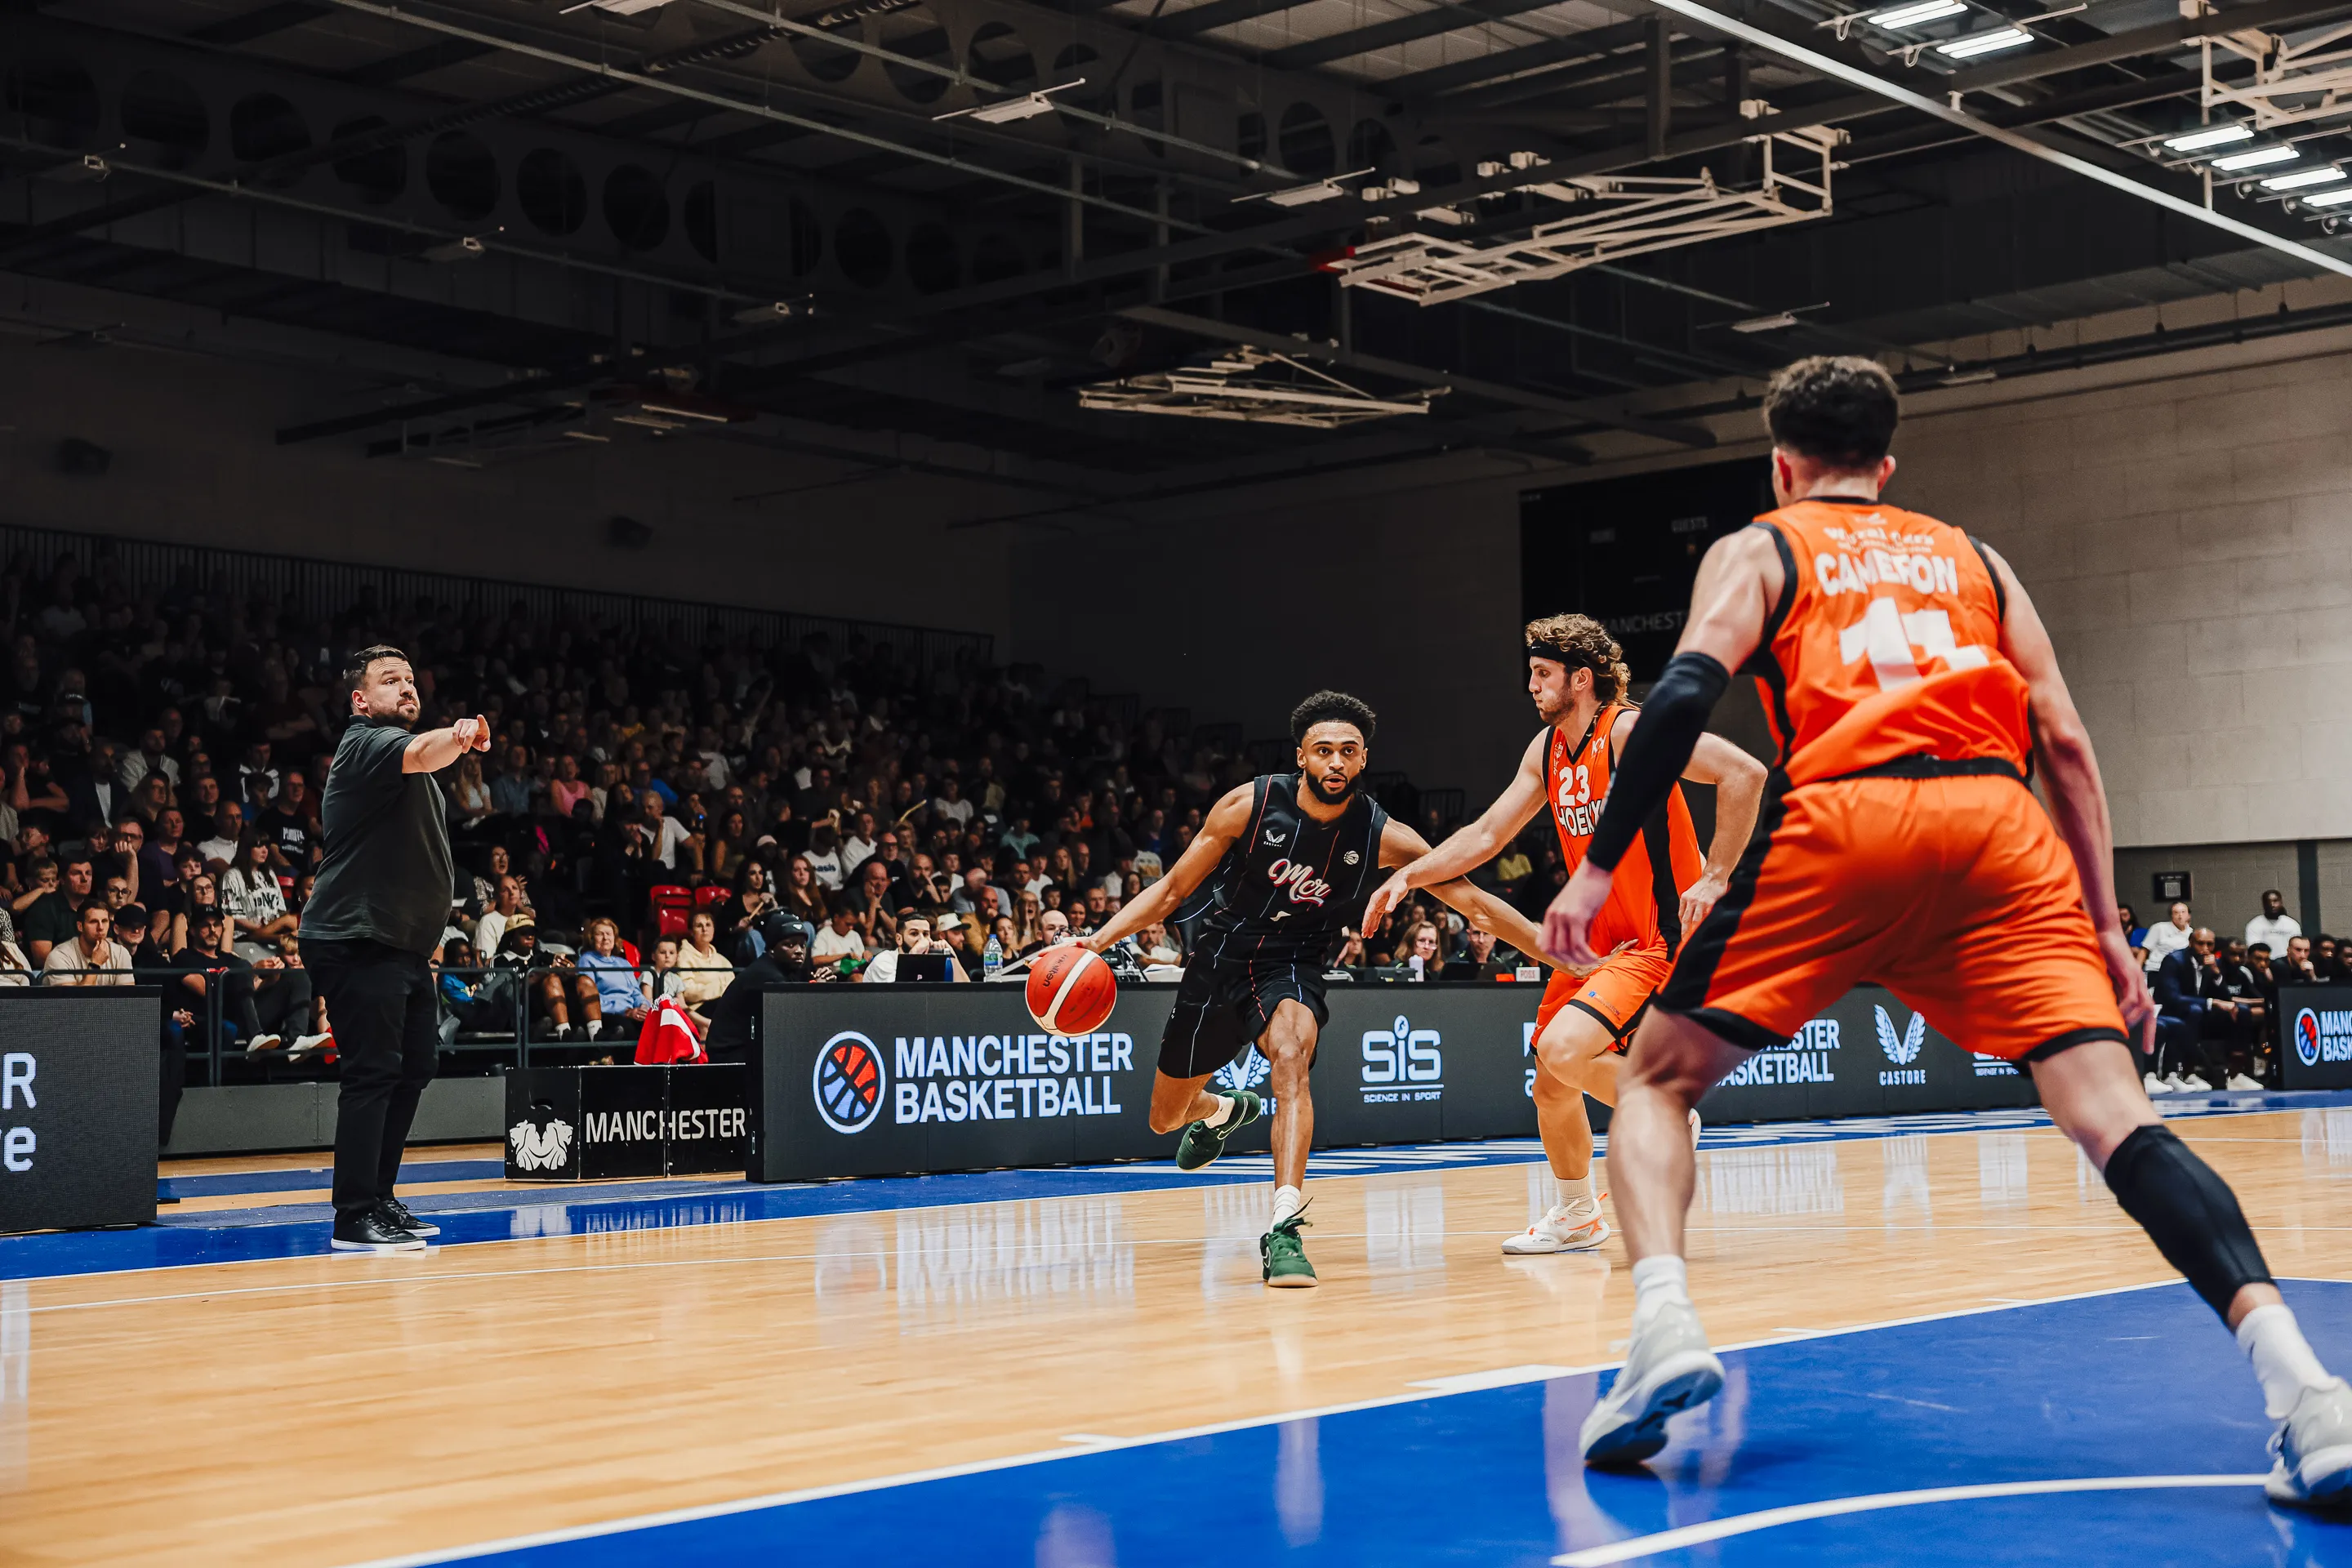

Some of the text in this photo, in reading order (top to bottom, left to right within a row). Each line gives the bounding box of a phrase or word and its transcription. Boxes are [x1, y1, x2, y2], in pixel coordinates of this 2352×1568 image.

[1606, 611, 1689, 634] ANCHEST
[1558, 764, 1592, 807] 23
[1267, 858, 1333, 907] Mcr
[895, 1032, 1134, 1079] MANCHESTER
[1716, 1052, 1835, 1087] ASKETBALL
[1363, 1091, 1441, 1103] SCIENCE IN SPORT
[1879, 1069, 1926, 1086] CASTORE
[895, 1076, 1122, 1125] BASKETBALL
[586, 1107, 746, 1143] MANCHESTER
[0, 1126, 37, 1172] e
